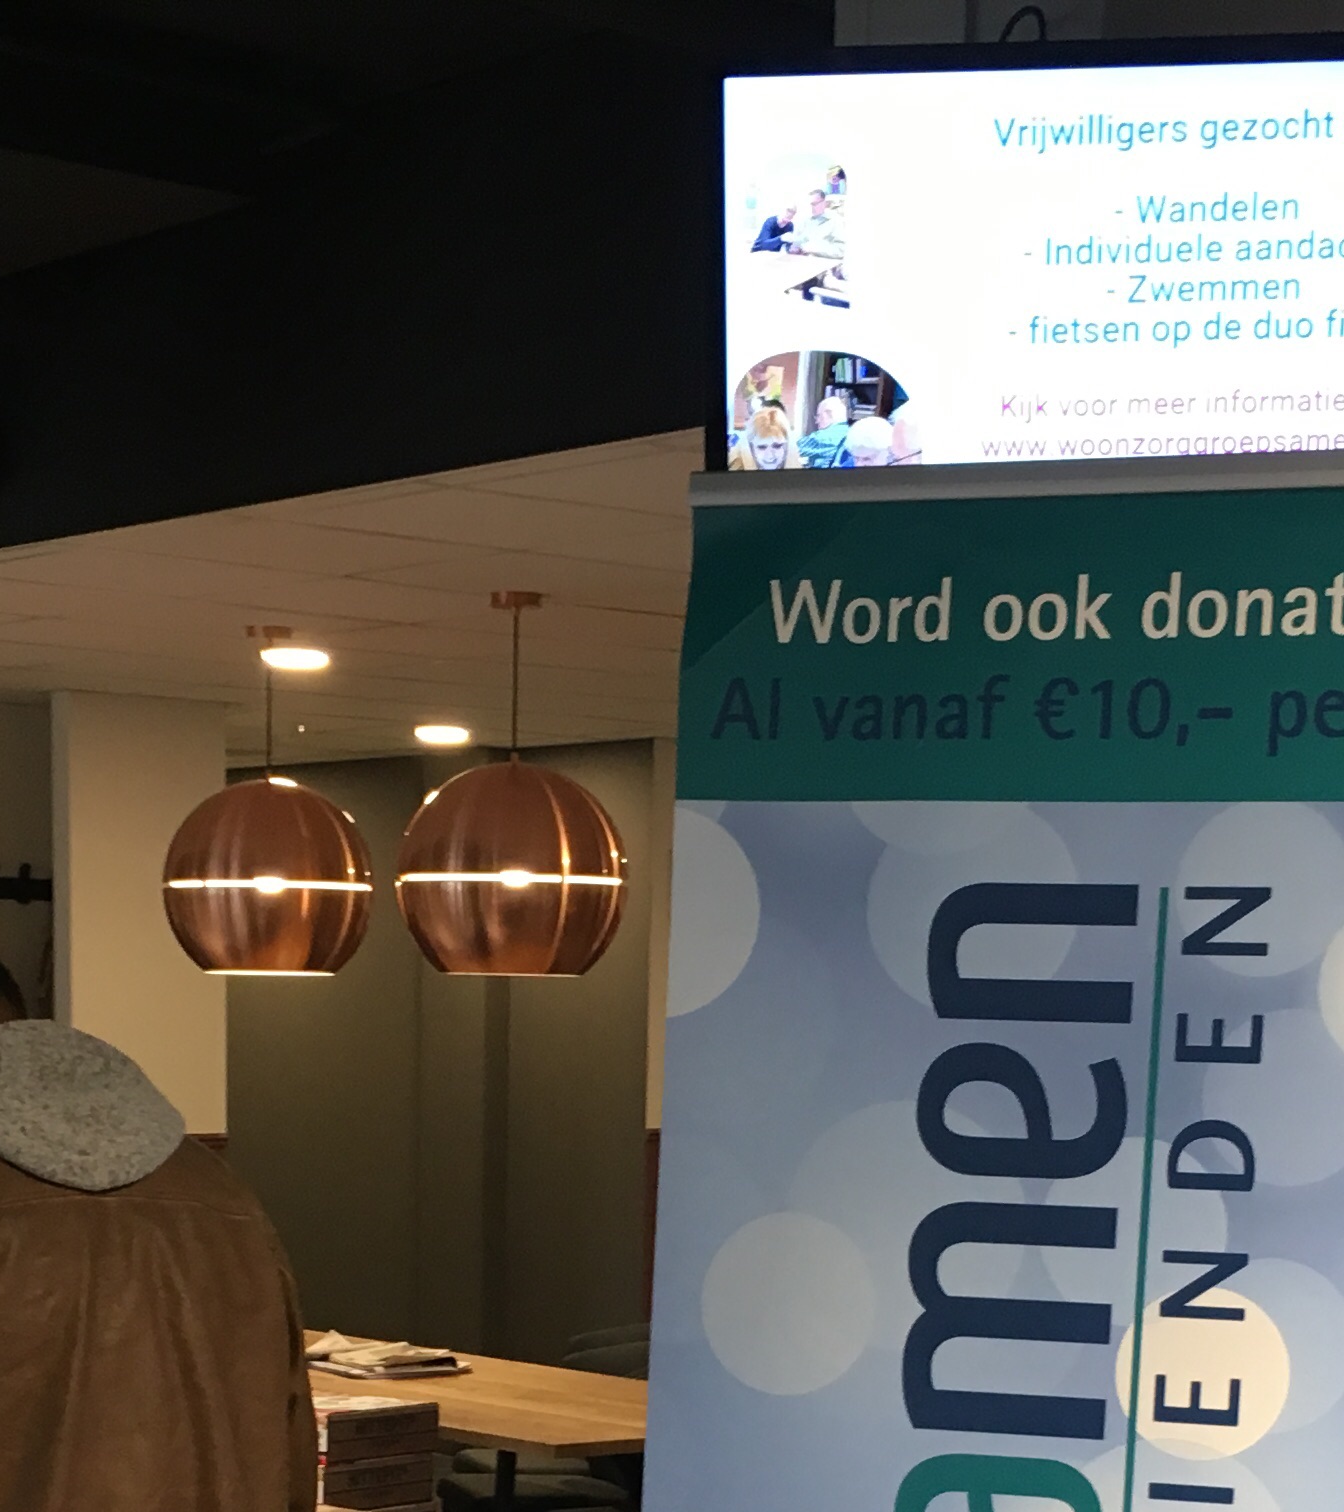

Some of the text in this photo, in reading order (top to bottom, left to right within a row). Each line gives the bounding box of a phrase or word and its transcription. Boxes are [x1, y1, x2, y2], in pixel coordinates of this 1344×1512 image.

[994, 113, 1188, 154] Vrijwilligers
[1199, 108, 1334, 149] gezocht
[1135, 190, 1300, 224] Wandelen
[1045, 232, 1223, 265] Individuele
[1127, 274, 1301, 303] Zwemmen
[1029, 315, 1140, 344] fietsen
[1151, 318, 1191, 348] op
[1202, 310, 1242, 341] de
[1253, 310, 1314, 340] duo
[1000, 393, 1049, 424] Kijk
[1058, 396, 1118, 416] voor
[1127, 394, 1196, 416] meer
[769, 576, 954, 646] Word
[981, 573, 1114, 641] ook
[709, 676, 784, 742] Al
[812, 673, 1010, 742] vanaf
